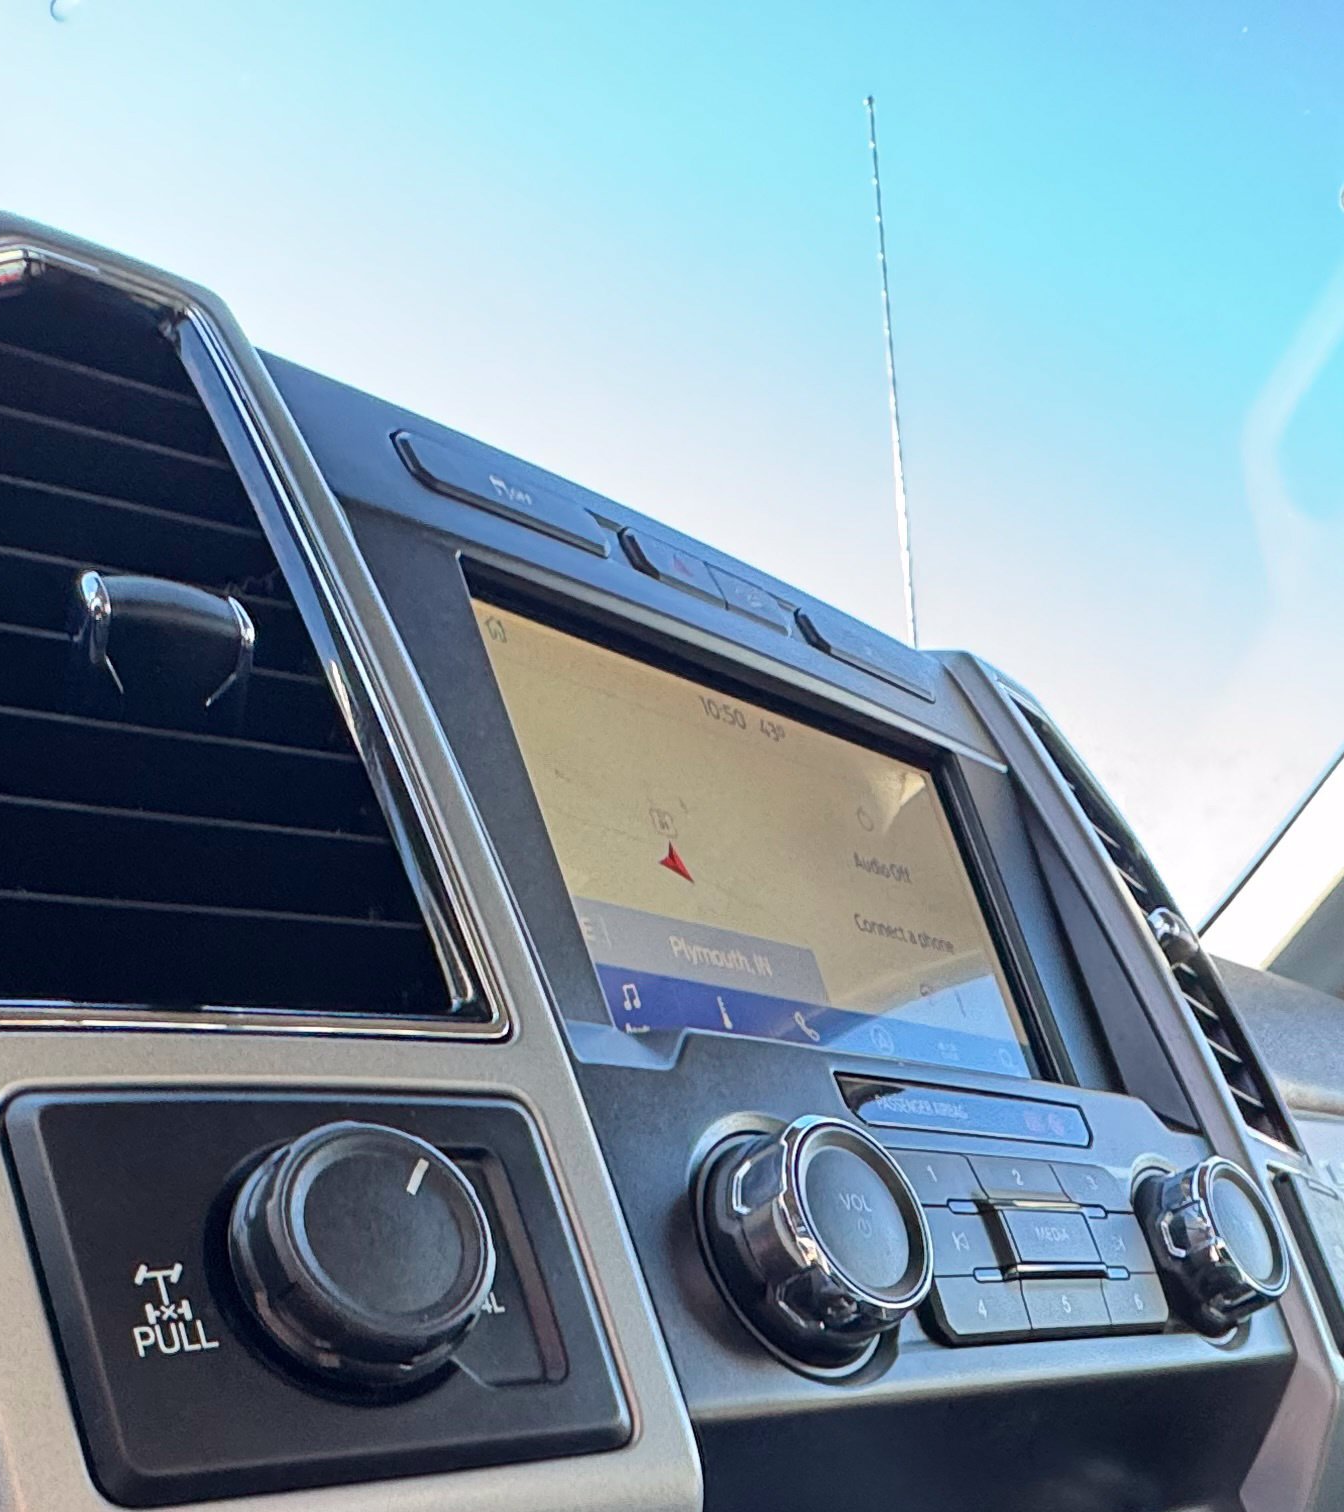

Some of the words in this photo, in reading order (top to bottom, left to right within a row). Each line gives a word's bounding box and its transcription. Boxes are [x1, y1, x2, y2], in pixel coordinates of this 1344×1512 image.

[700, 696, 746, 730] 10:50
[854, 913, 907, 943] Connect
[1011, 1168, 1023, 1187] 2
[839, 1192, 872, 1214] VOL
[977, 1300, 989, 1319] 4
[1061, 1293, 1073, 1314] 5
[1133, 1291, 1145, 1312] 6
[133, 1319, 219, 1358] PULL
